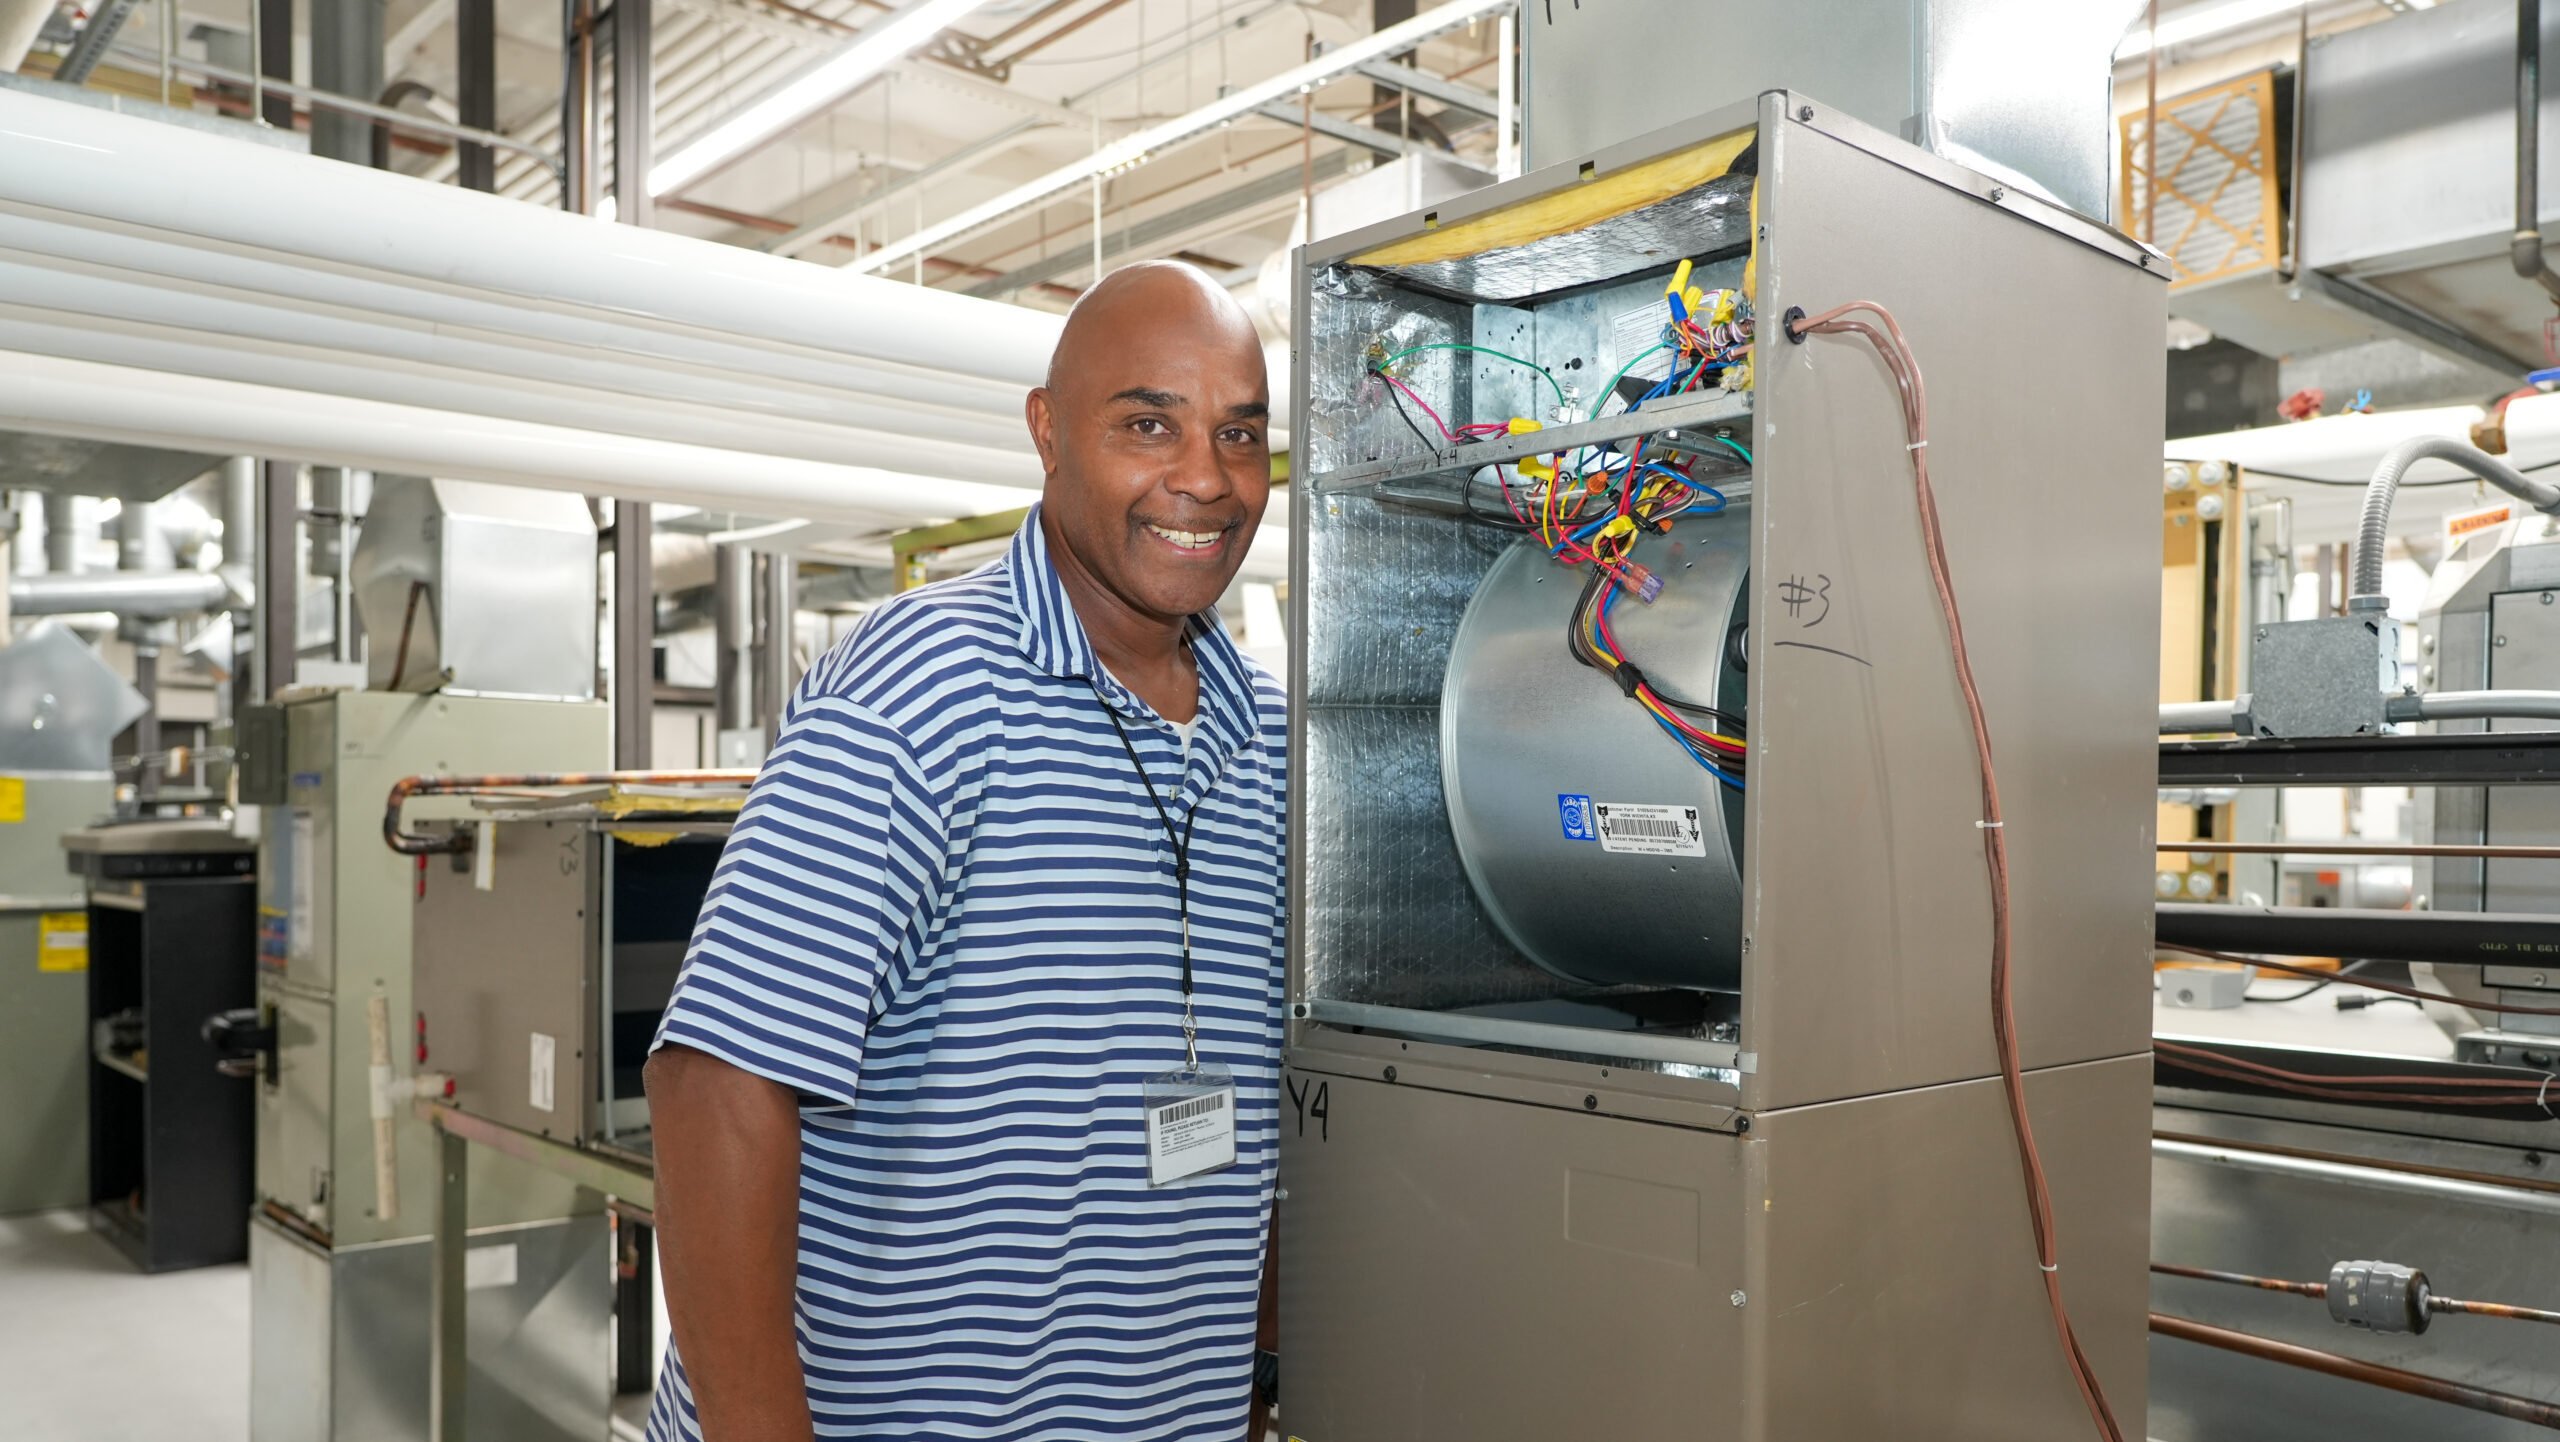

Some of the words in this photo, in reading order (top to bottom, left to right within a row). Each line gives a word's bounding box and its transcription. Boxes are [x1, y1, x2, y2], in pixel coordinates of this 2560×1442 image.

[1435, 449, 1457, 467] Y-4
[1778, 573, 1831, 628] #3
[560, 834, 579, 877] Y3
[1286, 1074, 1328, 1143] Y4
